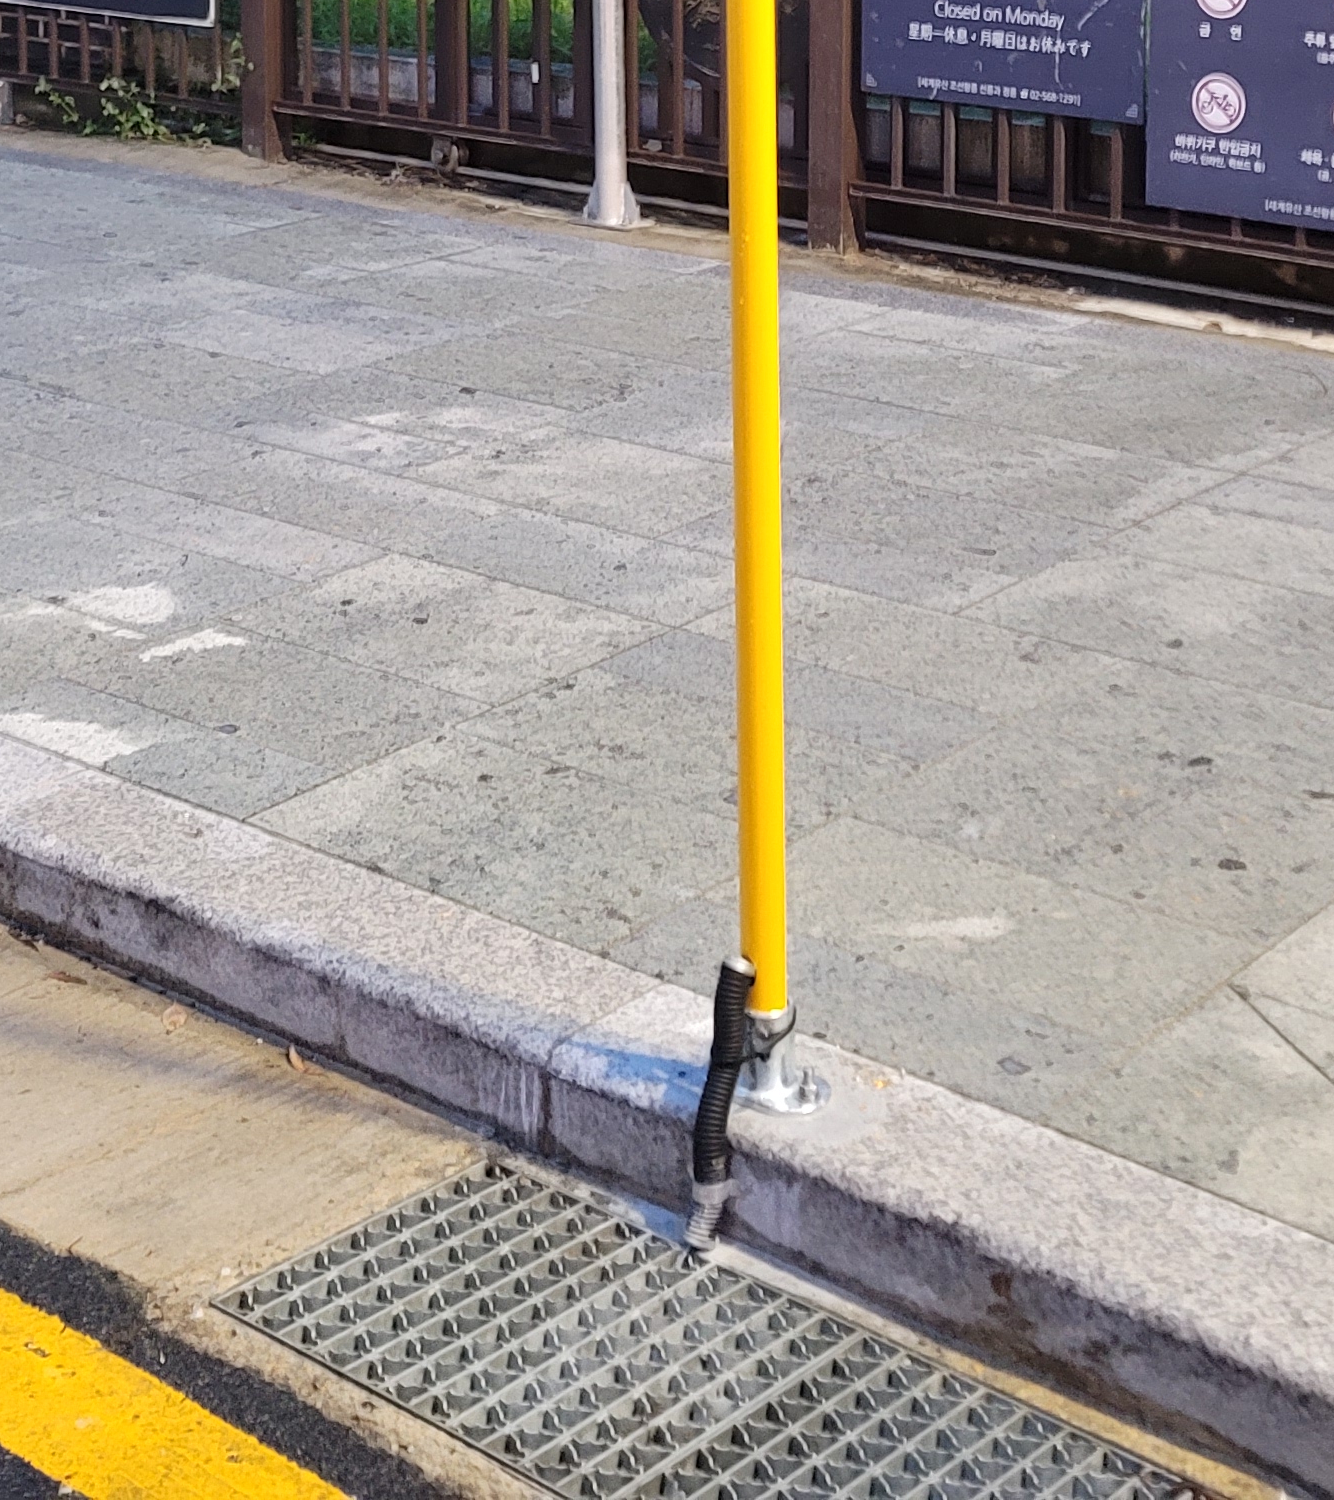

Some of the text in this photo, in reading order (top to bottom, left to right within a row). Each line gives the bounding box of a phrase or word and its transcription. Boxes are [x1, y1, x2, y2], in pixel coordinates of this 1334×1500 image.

[934, 0, 1065, 31] Closed on Monday
[1219, 138, 1262, 158] 반입금지
